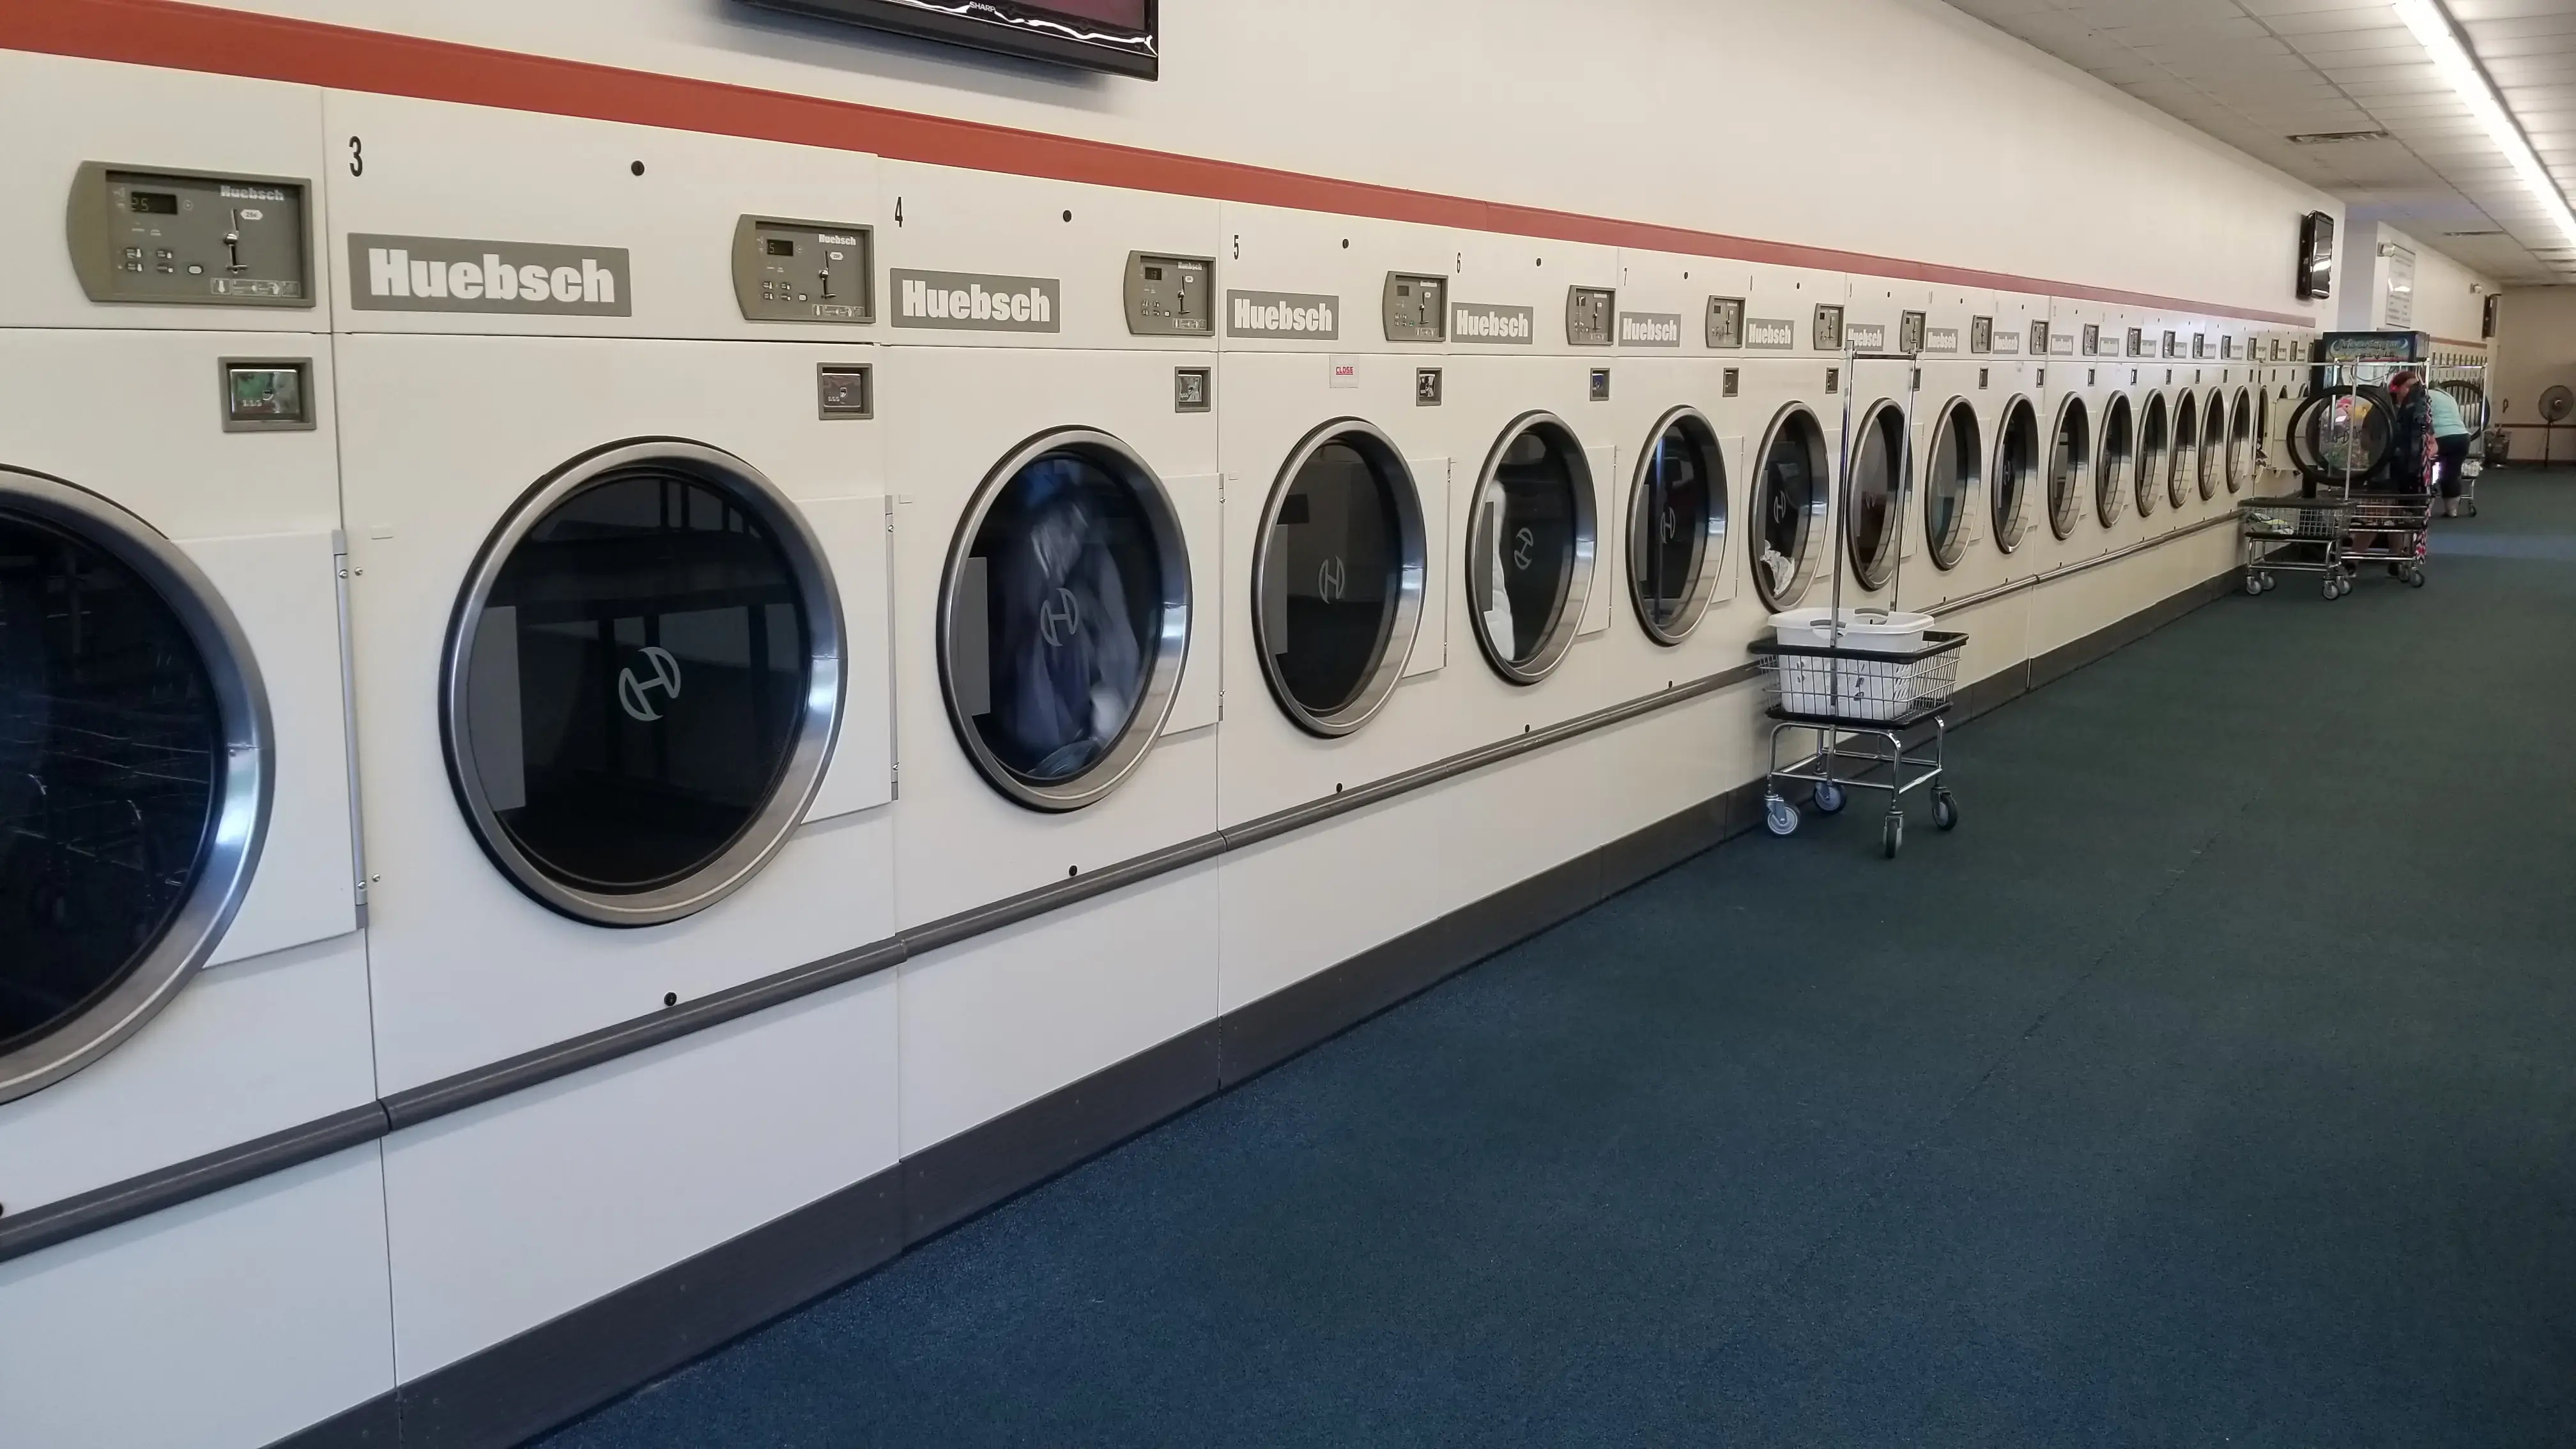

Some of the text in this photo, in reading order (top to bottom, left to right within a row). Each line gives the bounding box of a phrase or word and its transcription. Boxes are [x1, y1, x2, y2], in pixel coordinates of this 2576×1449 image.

[969, 1, 996, 12] SHARP
[349, 135, 363, 177] 3
[220, 185, 285, 201] Huebsch
[894, 196, 903, 227] 4
[818, 233, 857, 246] Huebsch
[1233, 234, 1239, 259] 5
[1456, 252, 1461, 273] 6
[369, 248, 615, 303] Huebsch
[903, 280, 1050, 322] Huebsch
[1234, 298, 1333, 332] Huebsch
[1456, 310, 1528, 337] Huebsch
[1623, 318, 1677, 341] Huebsch
[1749, 323, 1791, 344] Huebsch
